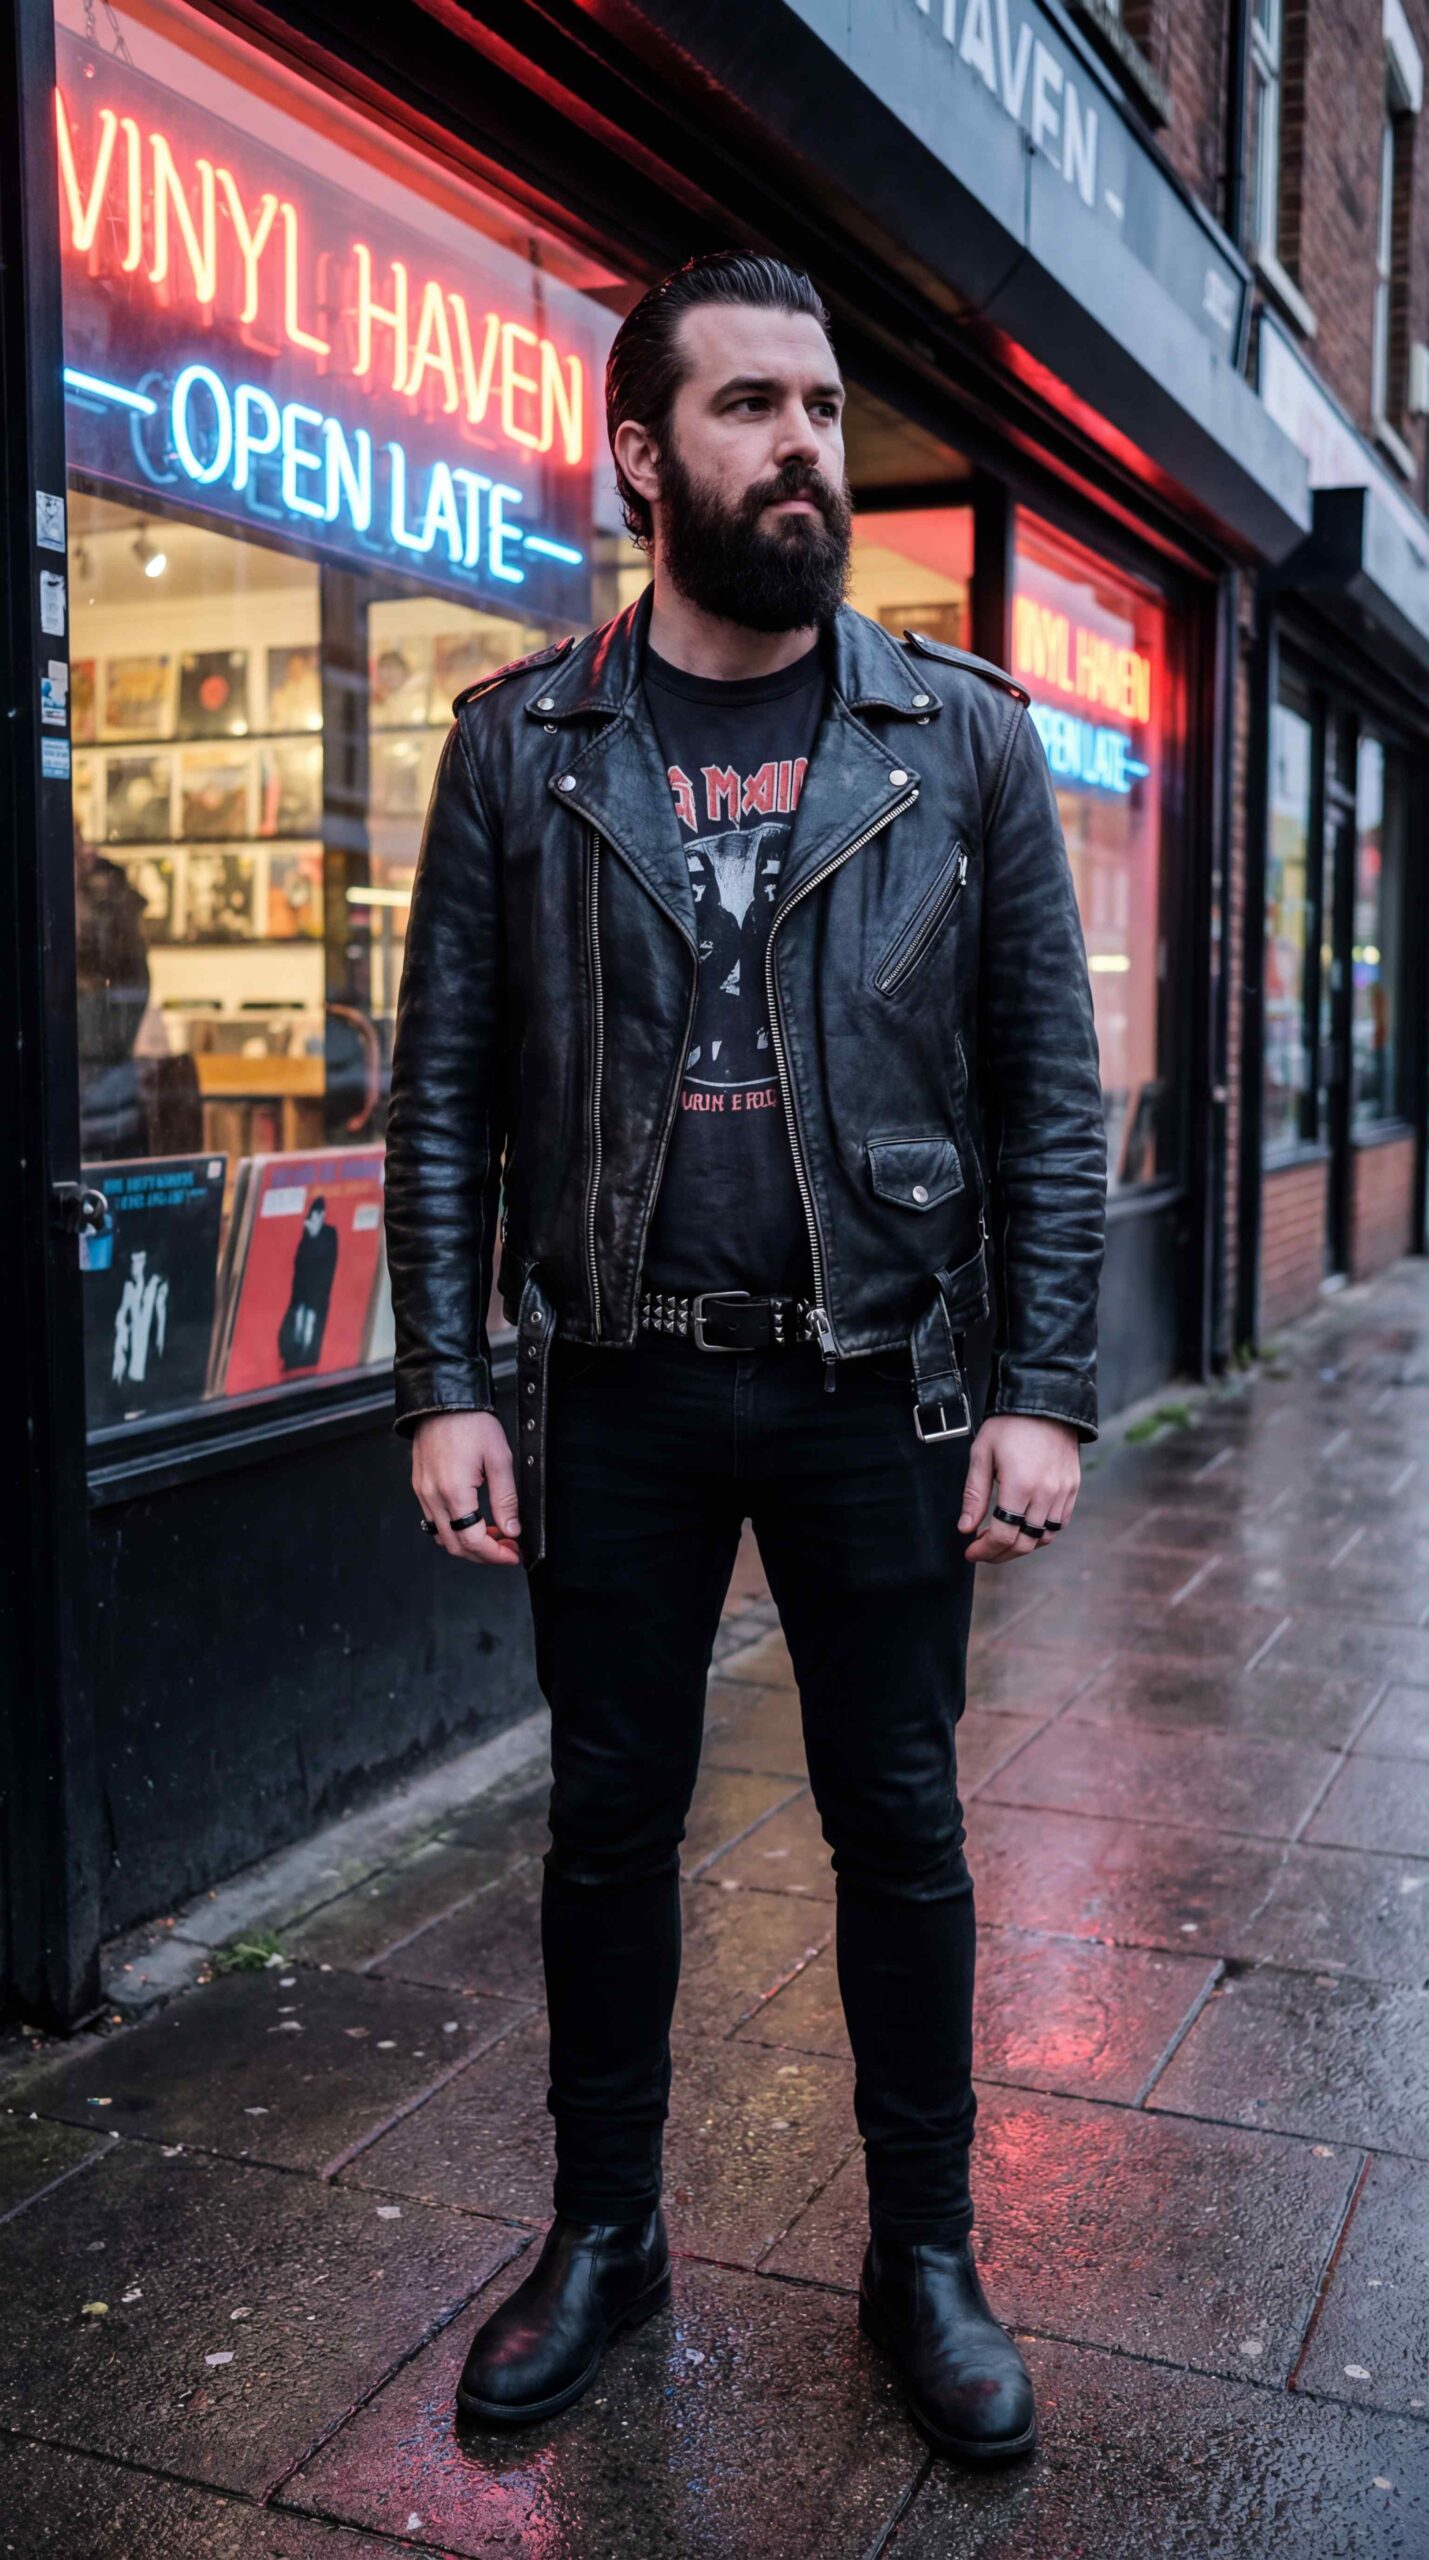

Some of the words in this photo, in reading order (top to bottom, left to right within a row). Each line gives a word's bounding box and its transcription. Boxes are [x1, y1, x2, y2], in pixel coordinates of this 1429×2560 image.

[56, 86, 331, 356] VINYL
[353, 244, 583, 465] HAVEN
[172, 365, 371, 531] OPEN
[386, 441, 525, 584] LATE
